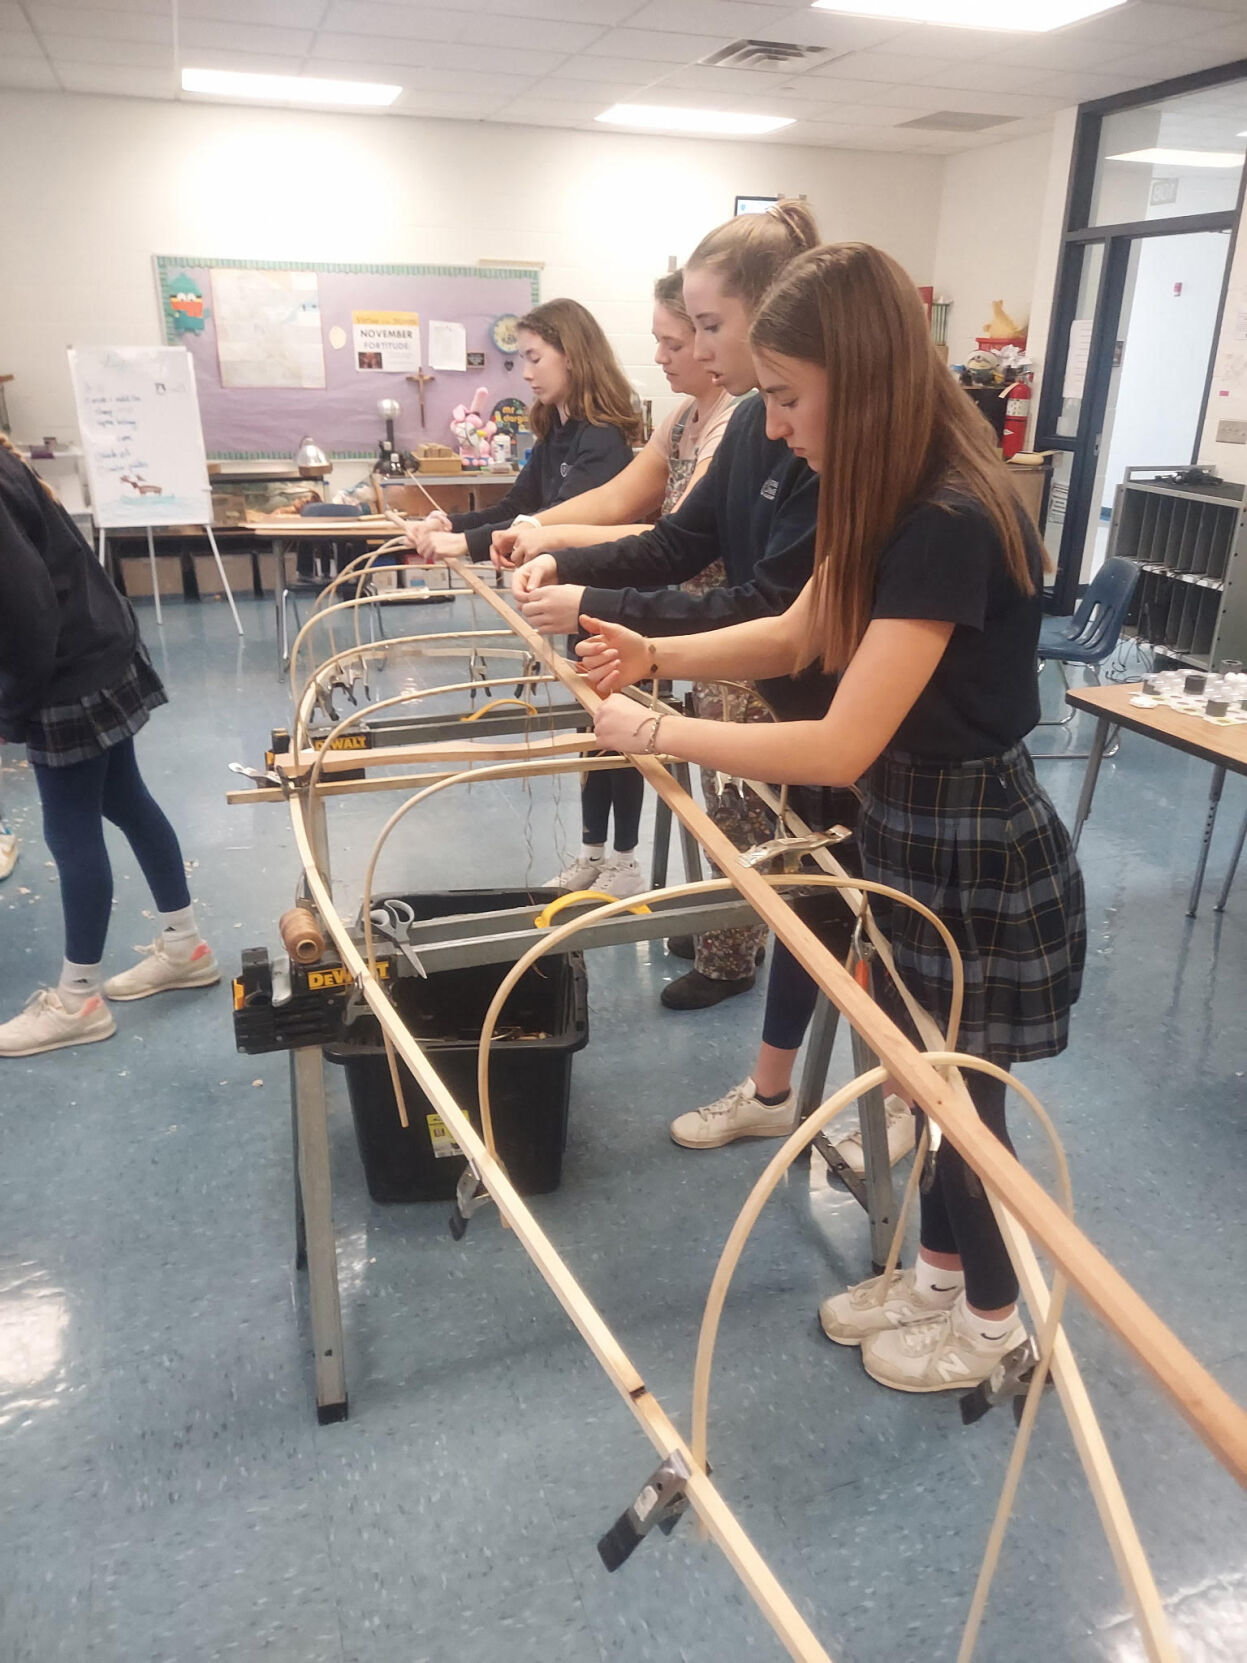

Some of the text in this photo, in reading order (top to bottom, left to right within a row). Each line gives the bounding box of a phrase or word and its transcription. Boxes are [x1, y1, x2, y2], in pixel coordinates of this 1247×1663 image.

[360, 329, 413, 339] NOVEMBER
[363, 341, 409, 350] FORTITUDE
[314, 736, 366, 750] DWALT
